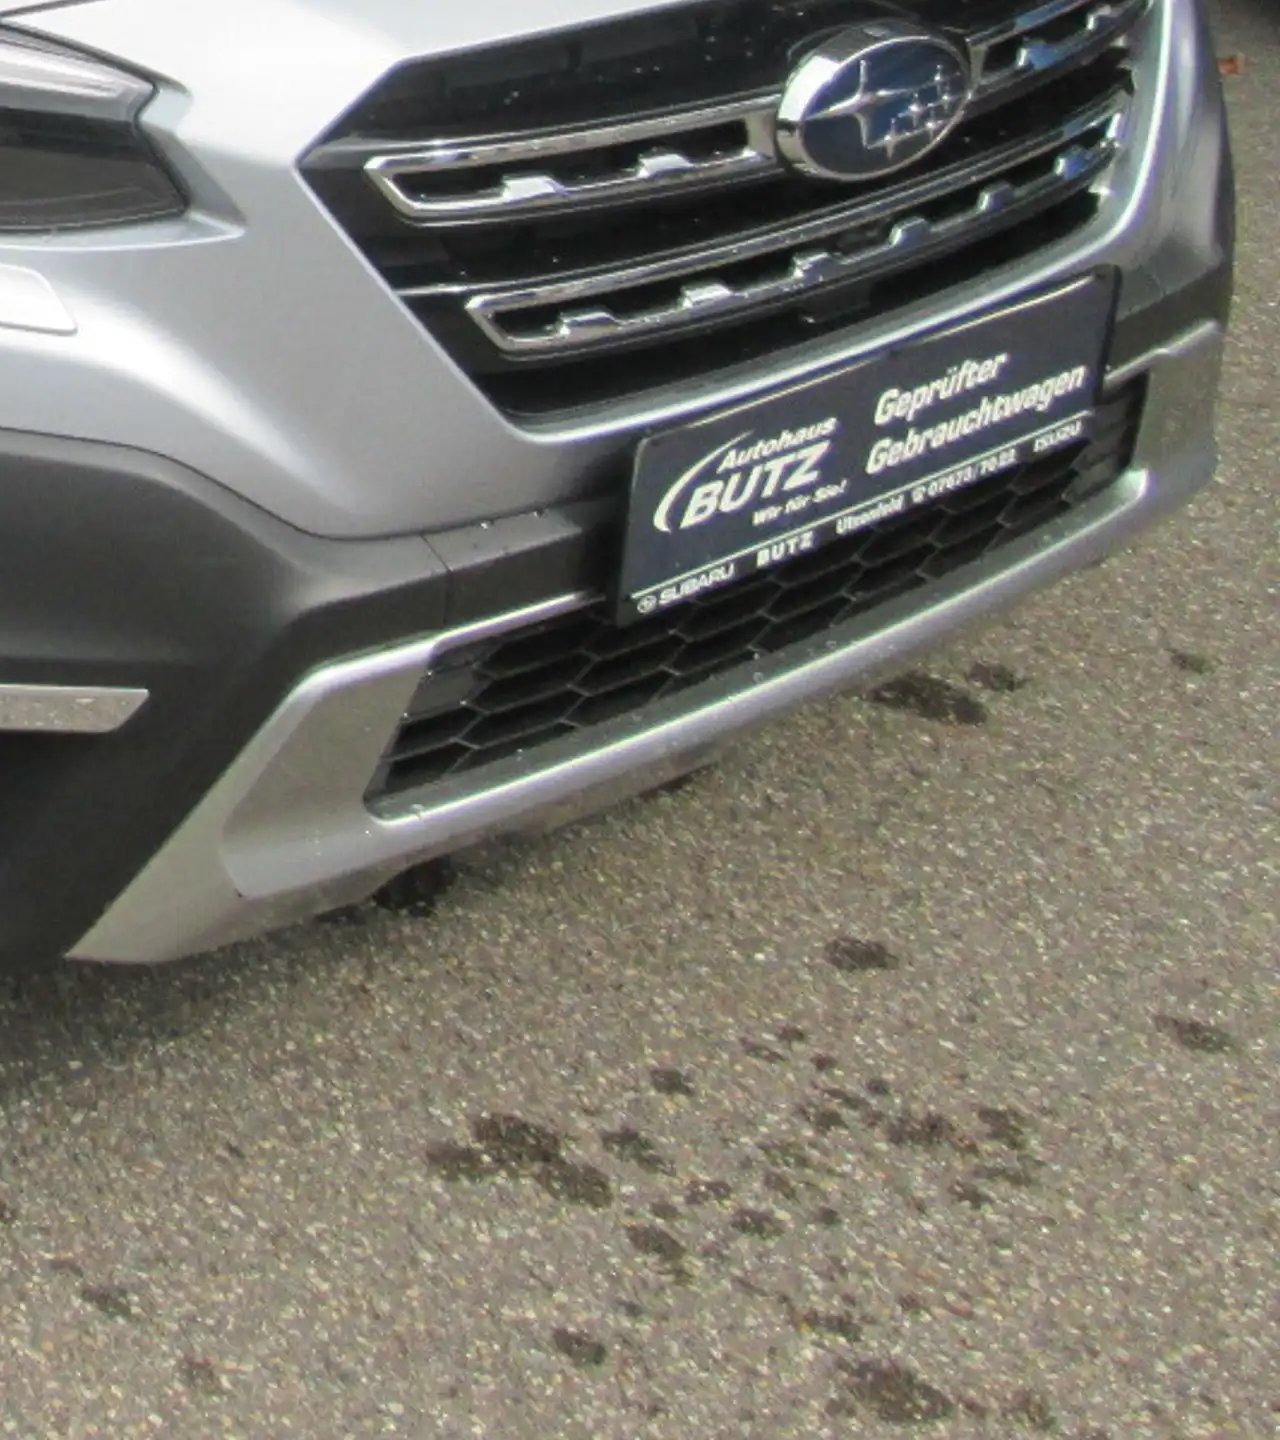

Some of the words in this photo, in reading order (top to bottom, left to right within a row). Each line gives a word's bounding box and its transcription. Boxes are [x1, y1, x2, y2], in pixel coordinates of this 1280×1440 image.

[865, 365, 1086, 475] Gebrauchtwagen
[874, 352, 1008, 426] Geprüfter
[678, 440, 830, 530] BUTZ
[715, 417, 837, 474] Autohaus
[658, 563, 735, 605] SUBARU
[756, 531, 814, 568] BUTZ
[1033, 420, 1083, 454] ISUZU
[752, 505, 782, 526] Wir
